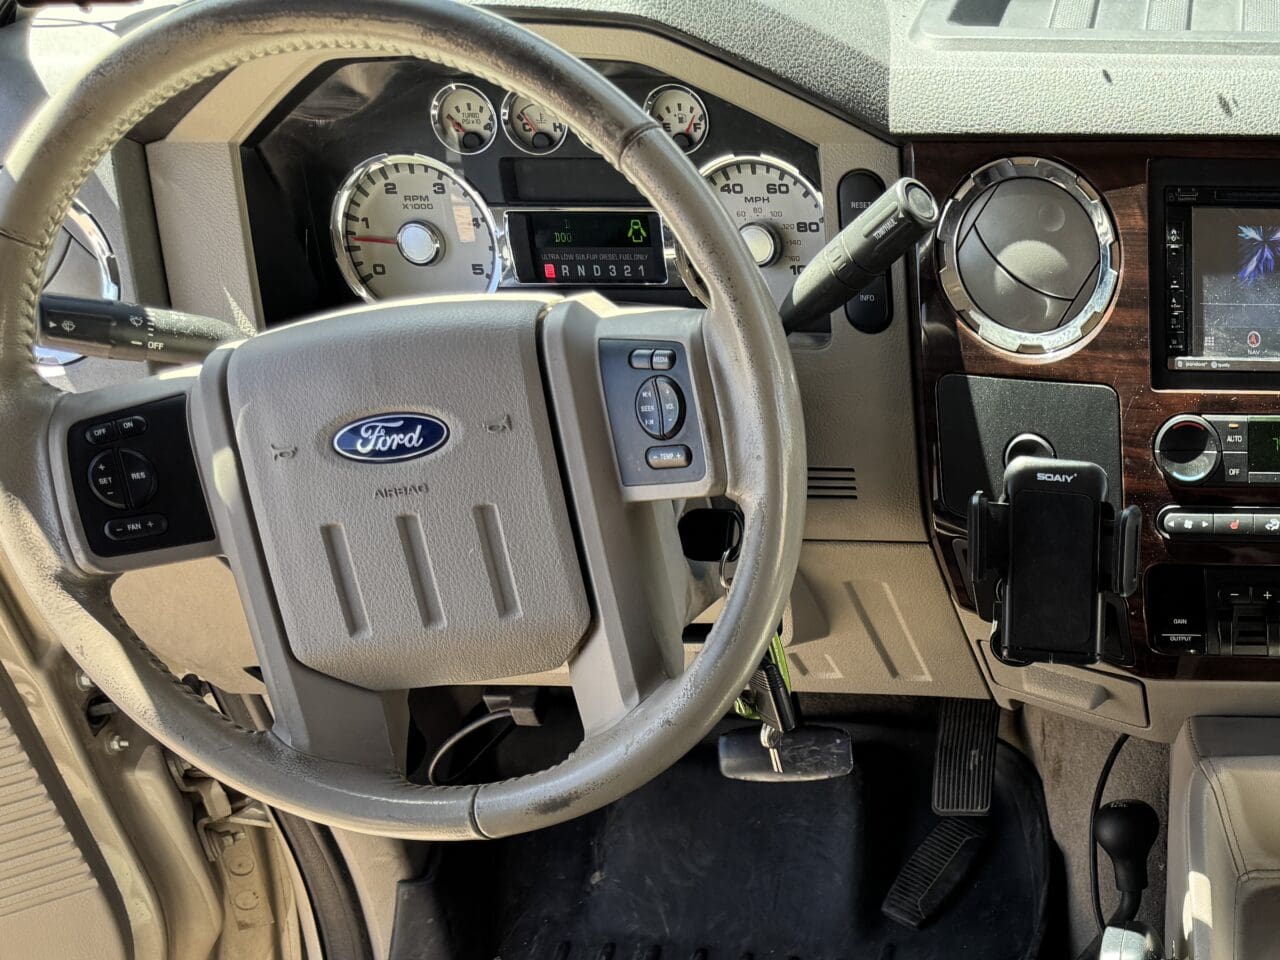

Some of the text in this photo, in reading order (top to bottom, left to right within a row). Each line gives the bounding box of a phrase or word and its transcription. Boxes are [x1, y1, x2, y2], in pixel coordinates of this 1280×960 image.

[553, 123, 563, 132] H
[693, 123, 702, 132] F
[384, 183, 398, 194] 2
[433, 183, 446, 194] 3
[720, 183, 743, 194] 40
[766, 183, 789, 194] 60
[744, 196, 770, 204] MPH
[361, 217, 370, 228] 1
[796, 222, 820, 232] 80
[372, 263, 386, 275] 0
[472, 264, 484, 275] 5
[561, 265, 570, 276] R
[577, 265, 586, 276] N
[593, 265, 601, 276] D
[608, 265, 617, 276] 3
[623, 265, 632, 276] 2
[638, 265, 645, 276] 1
[147, 342, 164, 351] OFF
[123, 421, 134, 429] ON
[357, 421, 423, 454] Ford
[98, 477, 112, 485] SET
[131, 472, 146, 480] RES
[127, 523, 142, 531] FAN
